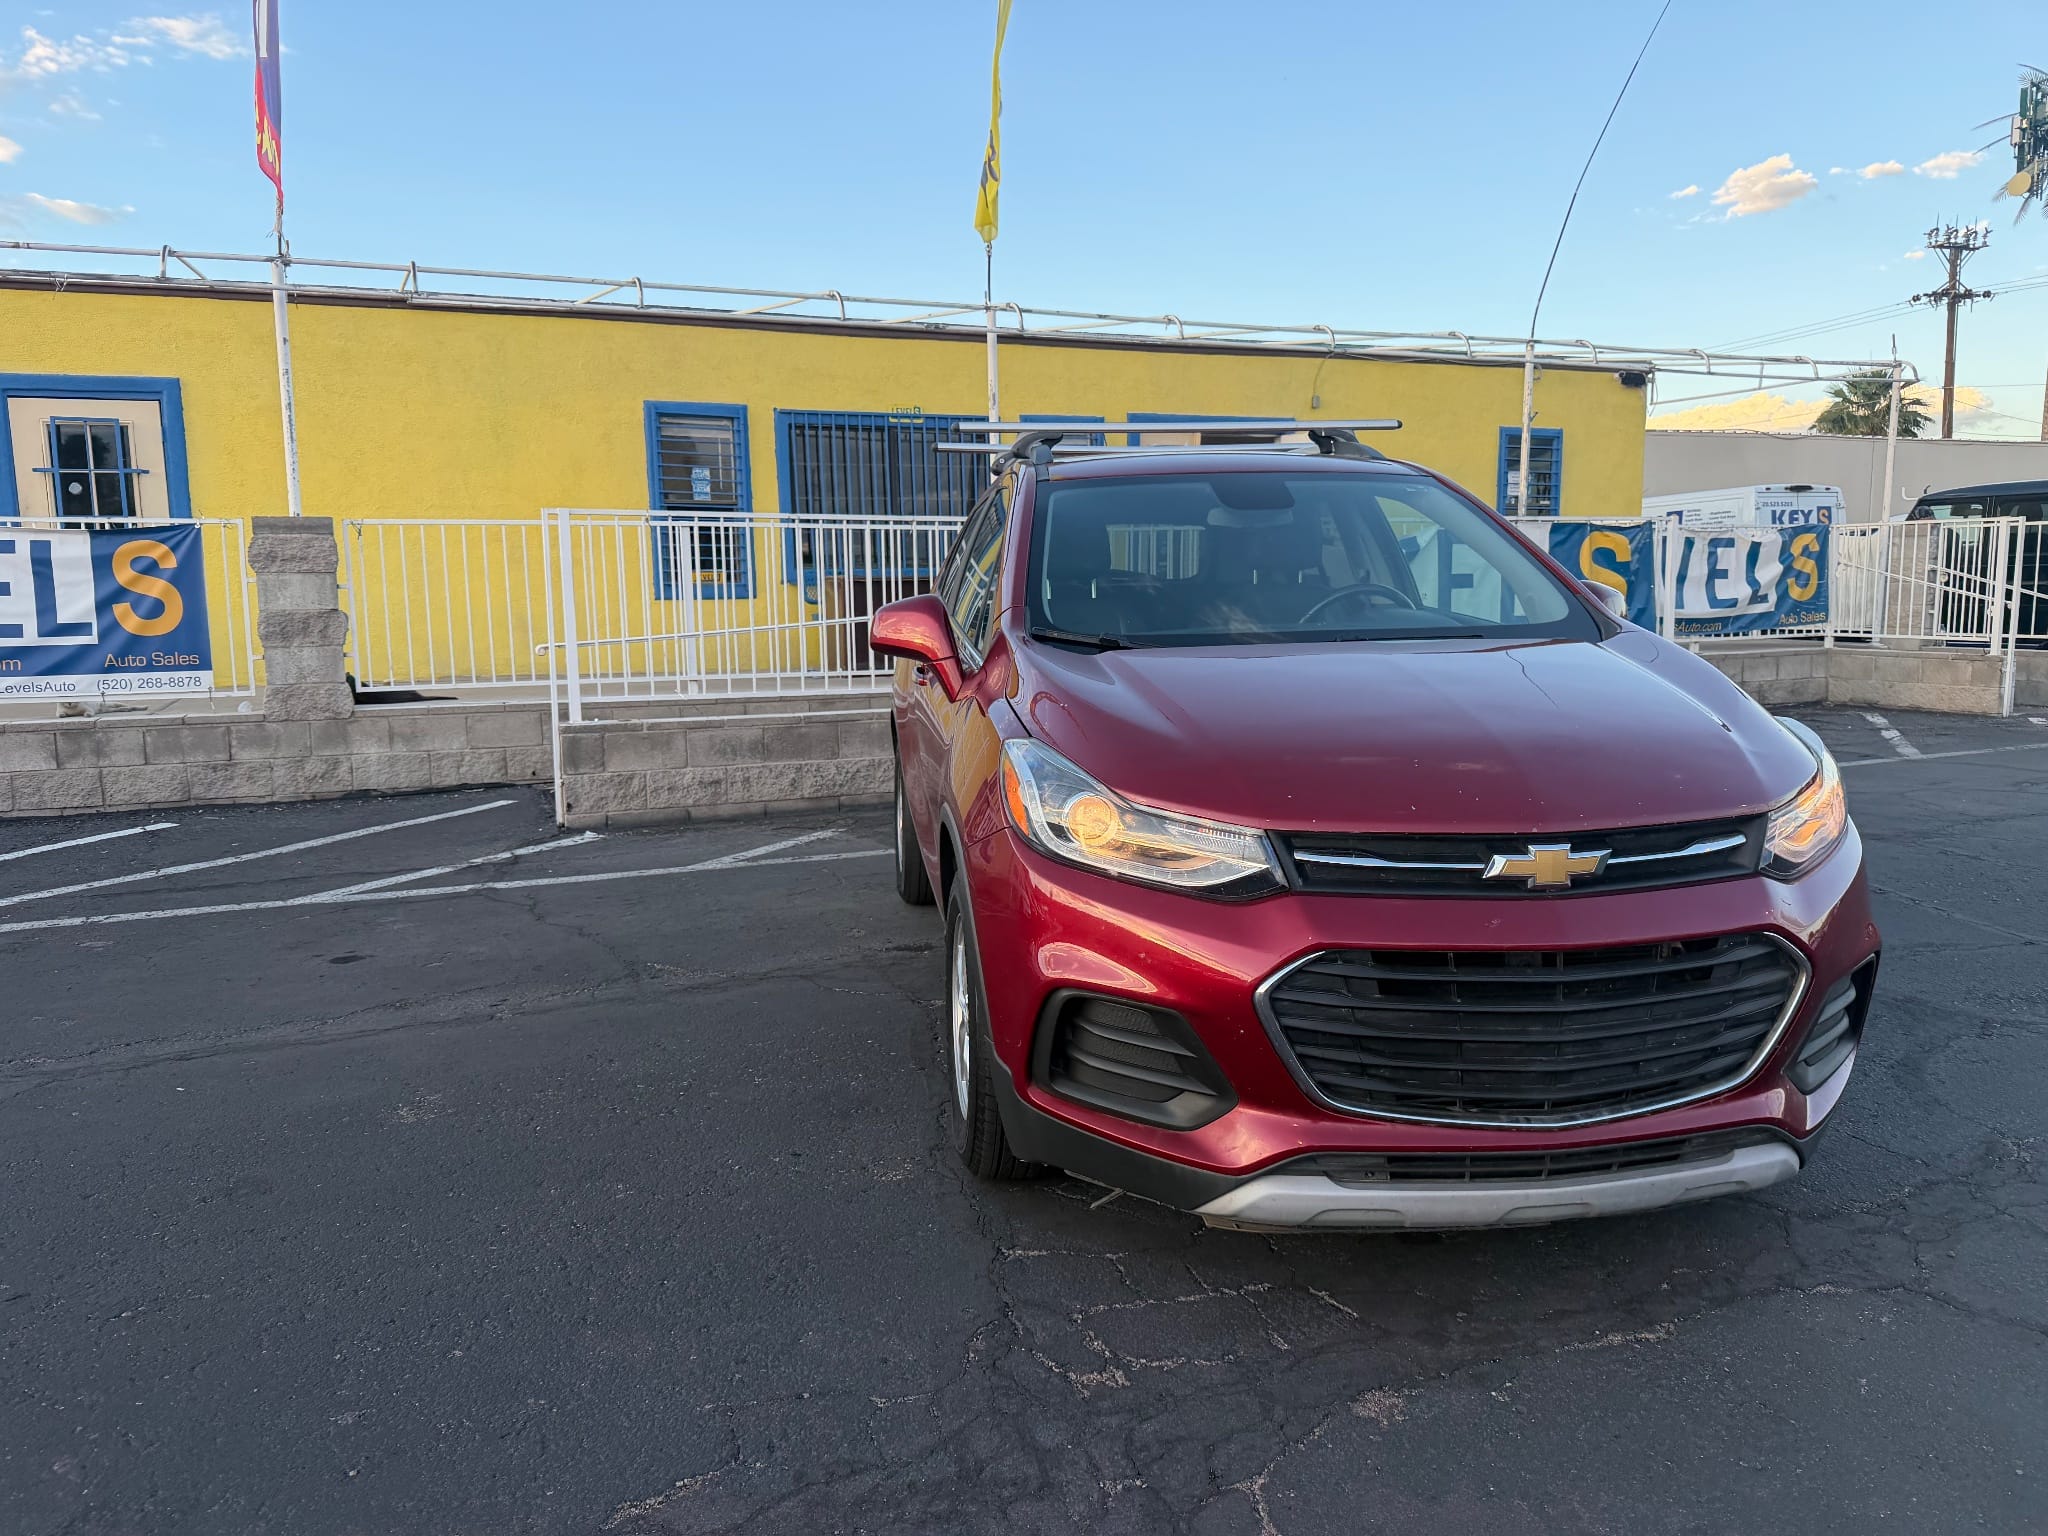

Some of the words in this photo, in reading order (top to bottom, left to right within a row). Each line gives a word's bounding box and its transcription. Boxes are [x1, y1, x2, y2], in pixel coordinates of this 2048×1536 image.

[1779, 613, 1798, 625] Auto
[1801, 611, 1826, 623] Sales
[104, 653, 147, 668] Auto
[152, 652, 199, 666] Sales
[97, 678, 133, 691] (520)
[138, 676, 202, 689] 268-8878
